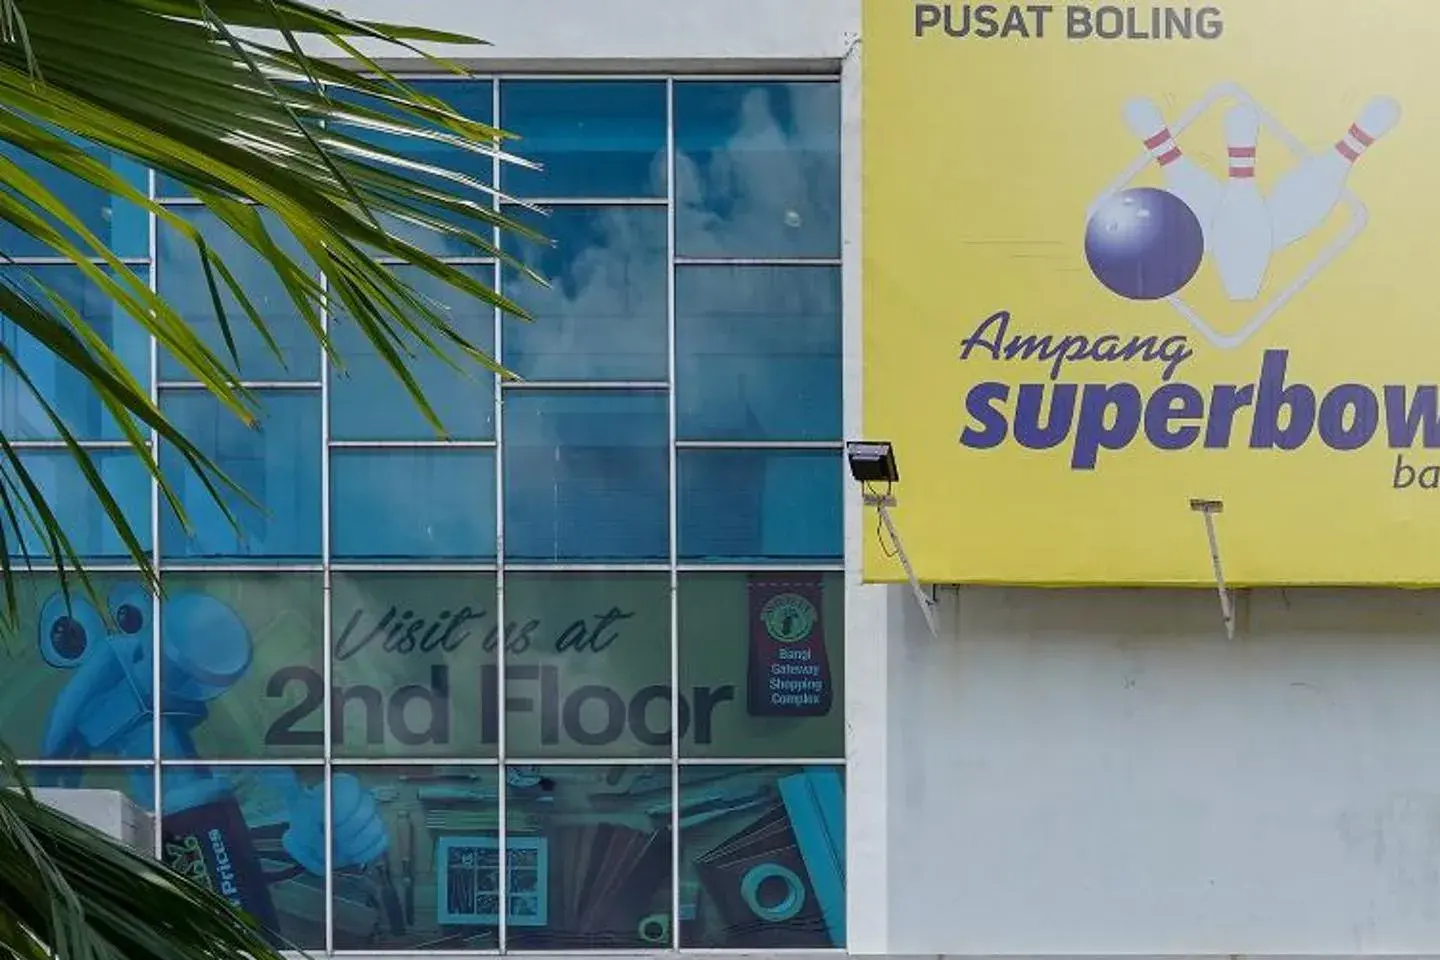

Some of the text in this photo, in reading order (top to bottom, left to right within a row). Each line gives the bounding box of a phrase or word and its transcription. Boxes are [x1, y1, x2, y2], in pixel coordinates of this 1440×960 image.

[914, 4, 1225, 40] PUSAT BOLING
[960, 311, 1194, 381] Ampang
[337, 606, 636, 661] Visit us at
[769, 677, 823, 693] Shopping
[770, 662, 821, 676] Gateway
[264, 664, 736, 746] 2nd Floor
